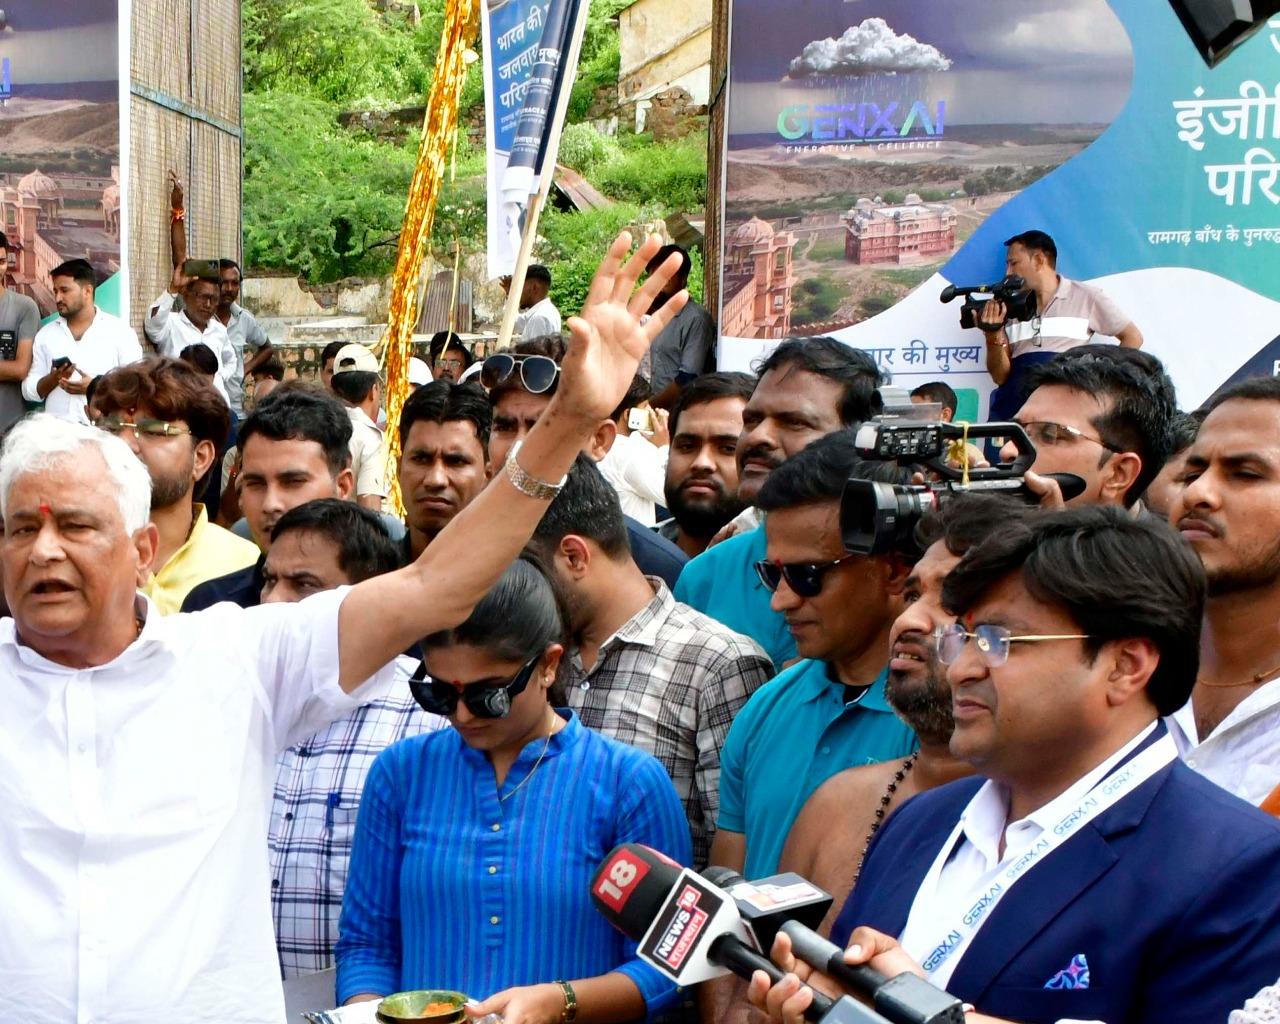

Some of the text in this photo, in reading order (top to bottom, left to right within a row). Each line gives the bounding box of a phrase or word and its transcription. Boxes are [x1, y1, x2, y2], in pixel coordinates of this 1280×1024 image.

[496, 21, 525, 50] भारत
[1225, 224, 1239, 242] के
[902, 340, 928, 364] की
[935, 346, 981, 371] मुख्य
[598, 859, 637, 900] 18
[962, 883, 1001, 925] GENXAI
[658, 910, 691, 957] NEWS
[922, 929, 961, 971] GENXAI
